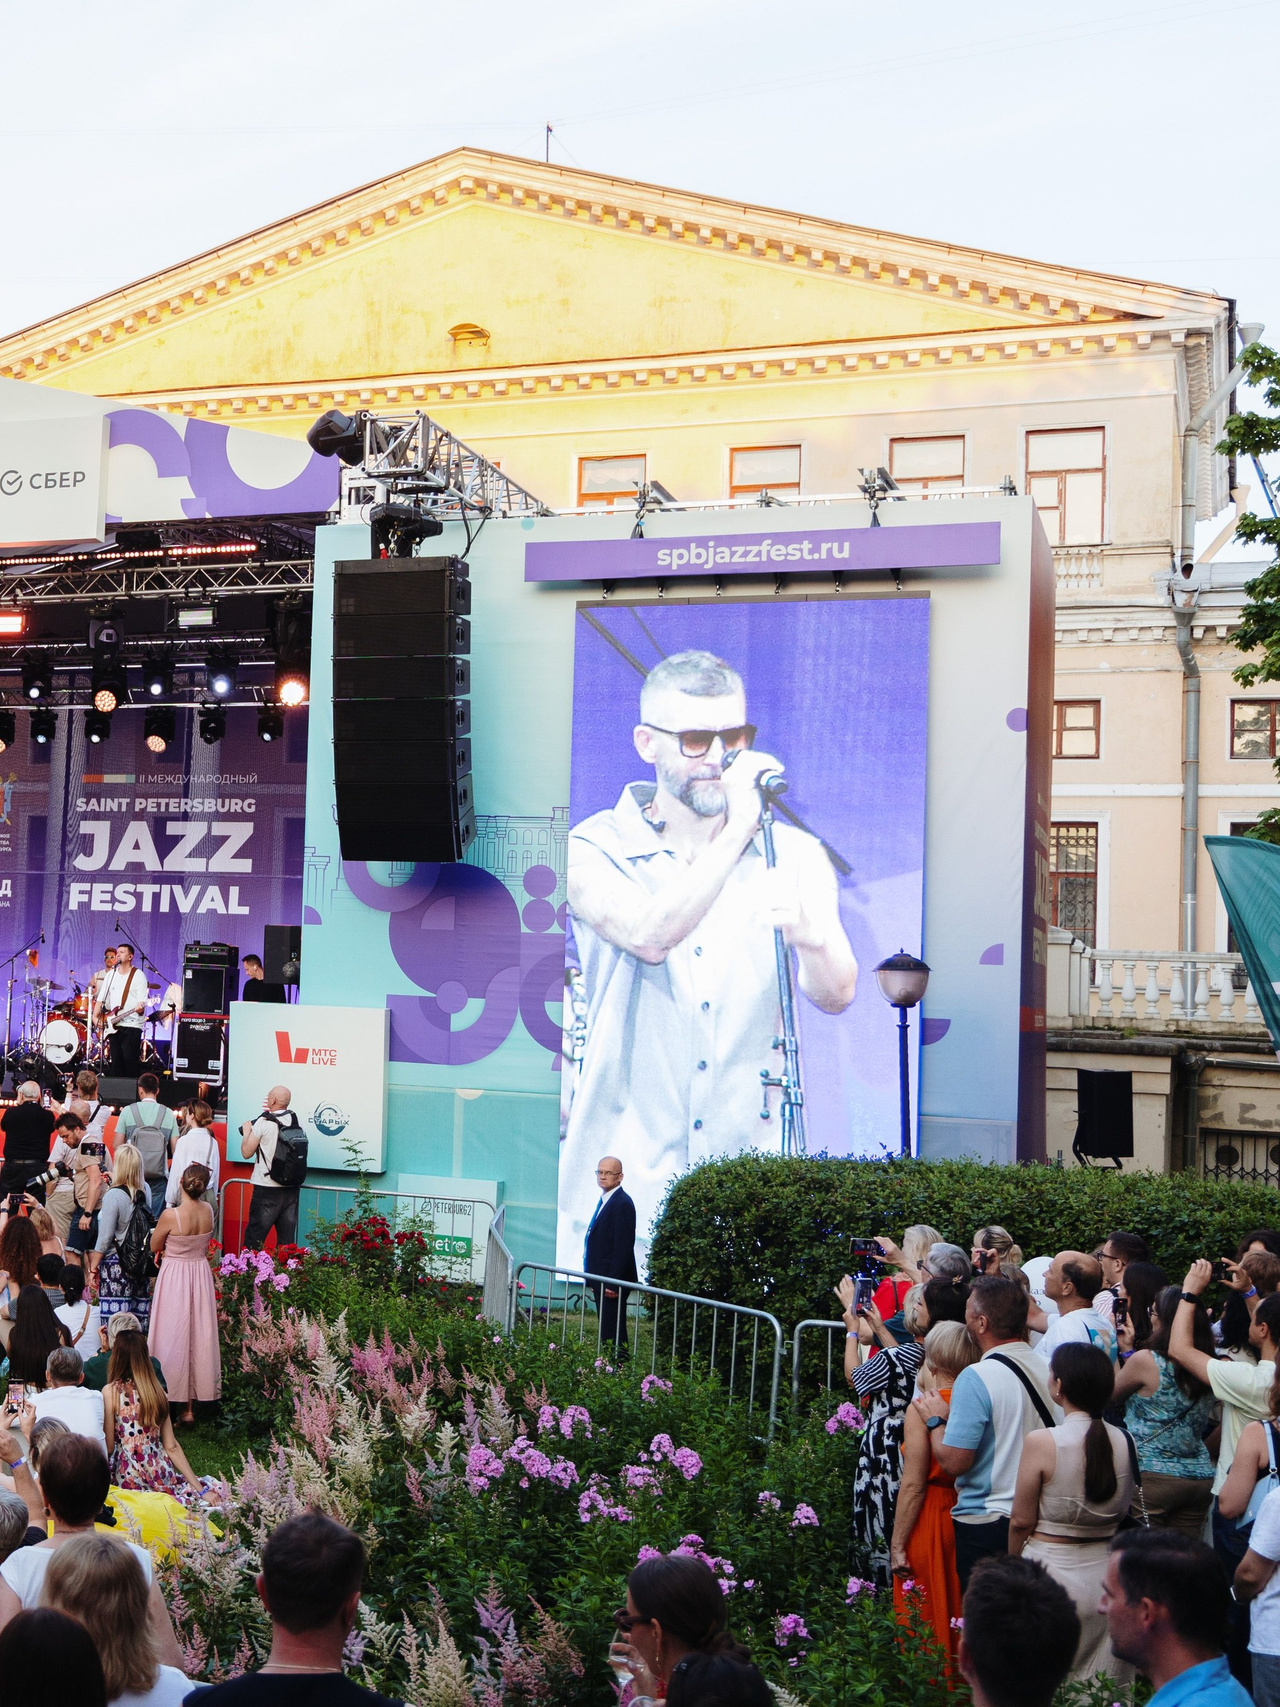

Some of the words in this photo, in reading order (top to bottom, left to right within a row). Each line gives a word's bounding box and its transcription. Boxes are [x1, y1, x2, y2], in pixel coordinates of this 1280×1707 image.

[29, 470, 86, 490] СБЕР
[656, 539, 850, 570] spbjazzfest.ru
[148, 772, 258, 785] МЕЖДУНАРОДНЫЙ
[76, 798, 131, 812] SAINT
[135, 798, 256, 813] PETERSBURG
[72, 820, 254, 873] JAZZ
[68, 882, 250, 915] FESTIVAL
[311, 1057, 337, 1066] LIVE
